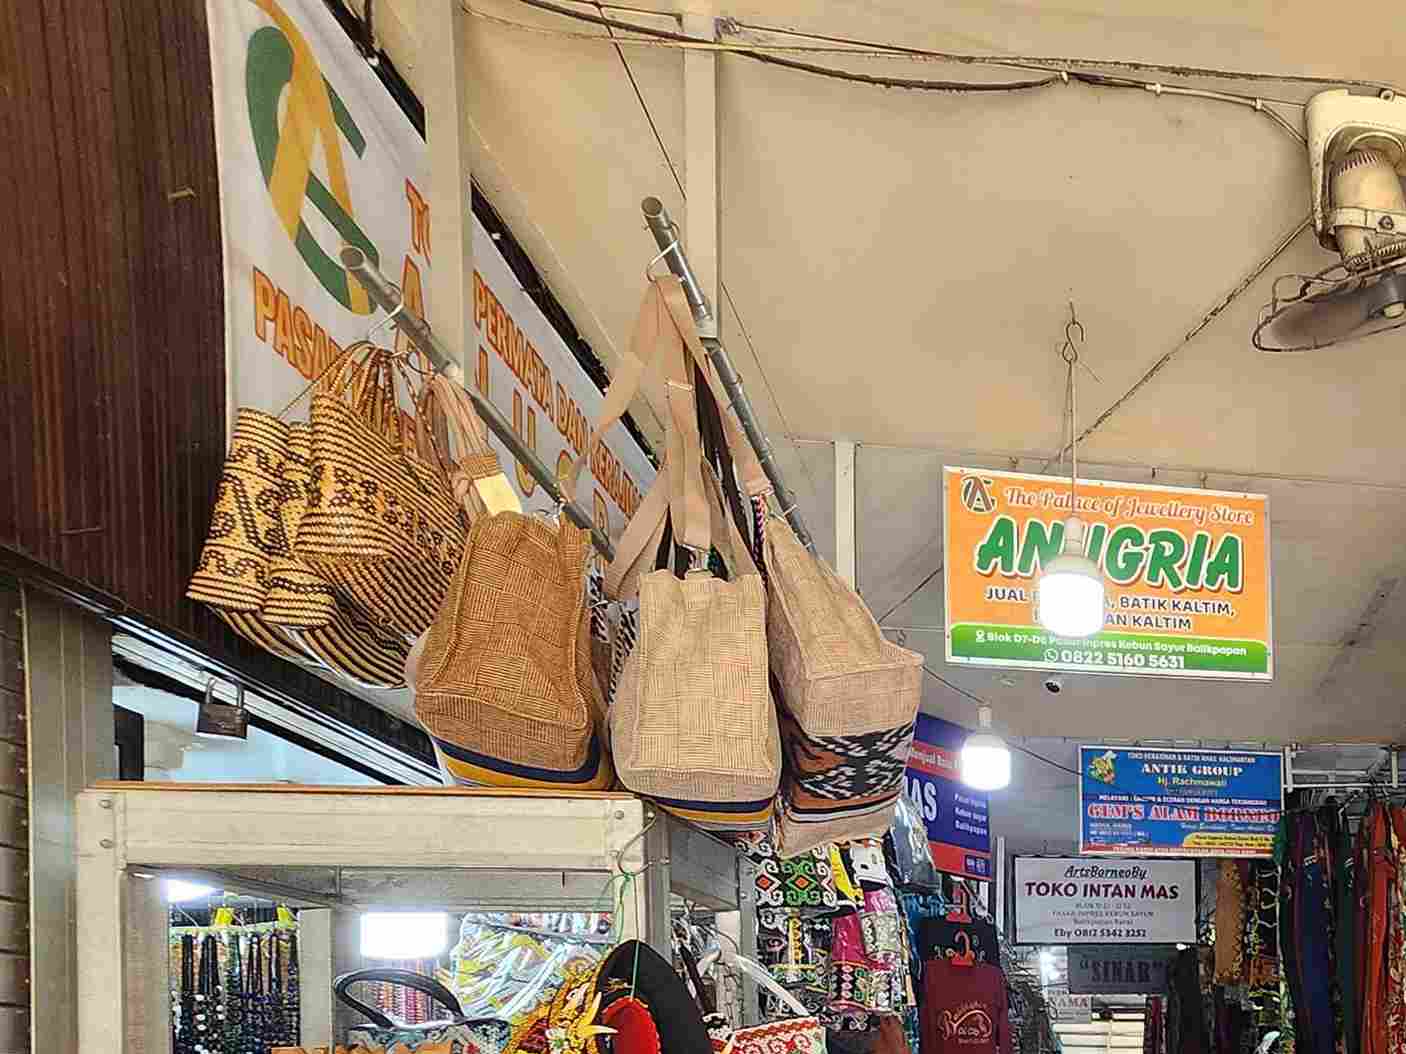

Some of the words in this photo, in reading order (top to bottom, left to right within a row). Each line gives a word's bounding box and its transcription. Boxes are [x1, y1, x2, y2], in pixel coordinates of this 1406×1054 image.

[1102, 495, 1121, 518] of
[1122, 497, 1209, 527] Jewellery
[1210, 504, 1253, 525] Store
[986, 588, 1028, 602] JUAL
[1120, 596, 1168, 611] BATIK
[1132, 615, 1193, 631] KALTIM
[1061, 649, 1104, 666] 0822
[1107, 652, 1145, 667] 5160
[1148, 653, 1185, 669] 5631
[1141, 763, 1188, 775] ANTIK
[1191, 764, 1244, 777] GROUP
[1025, 882, 1078, 898] TOKO
[1083, 883, 1137, 899] INTAN
[1140, 885, 1180, 900] MAS
